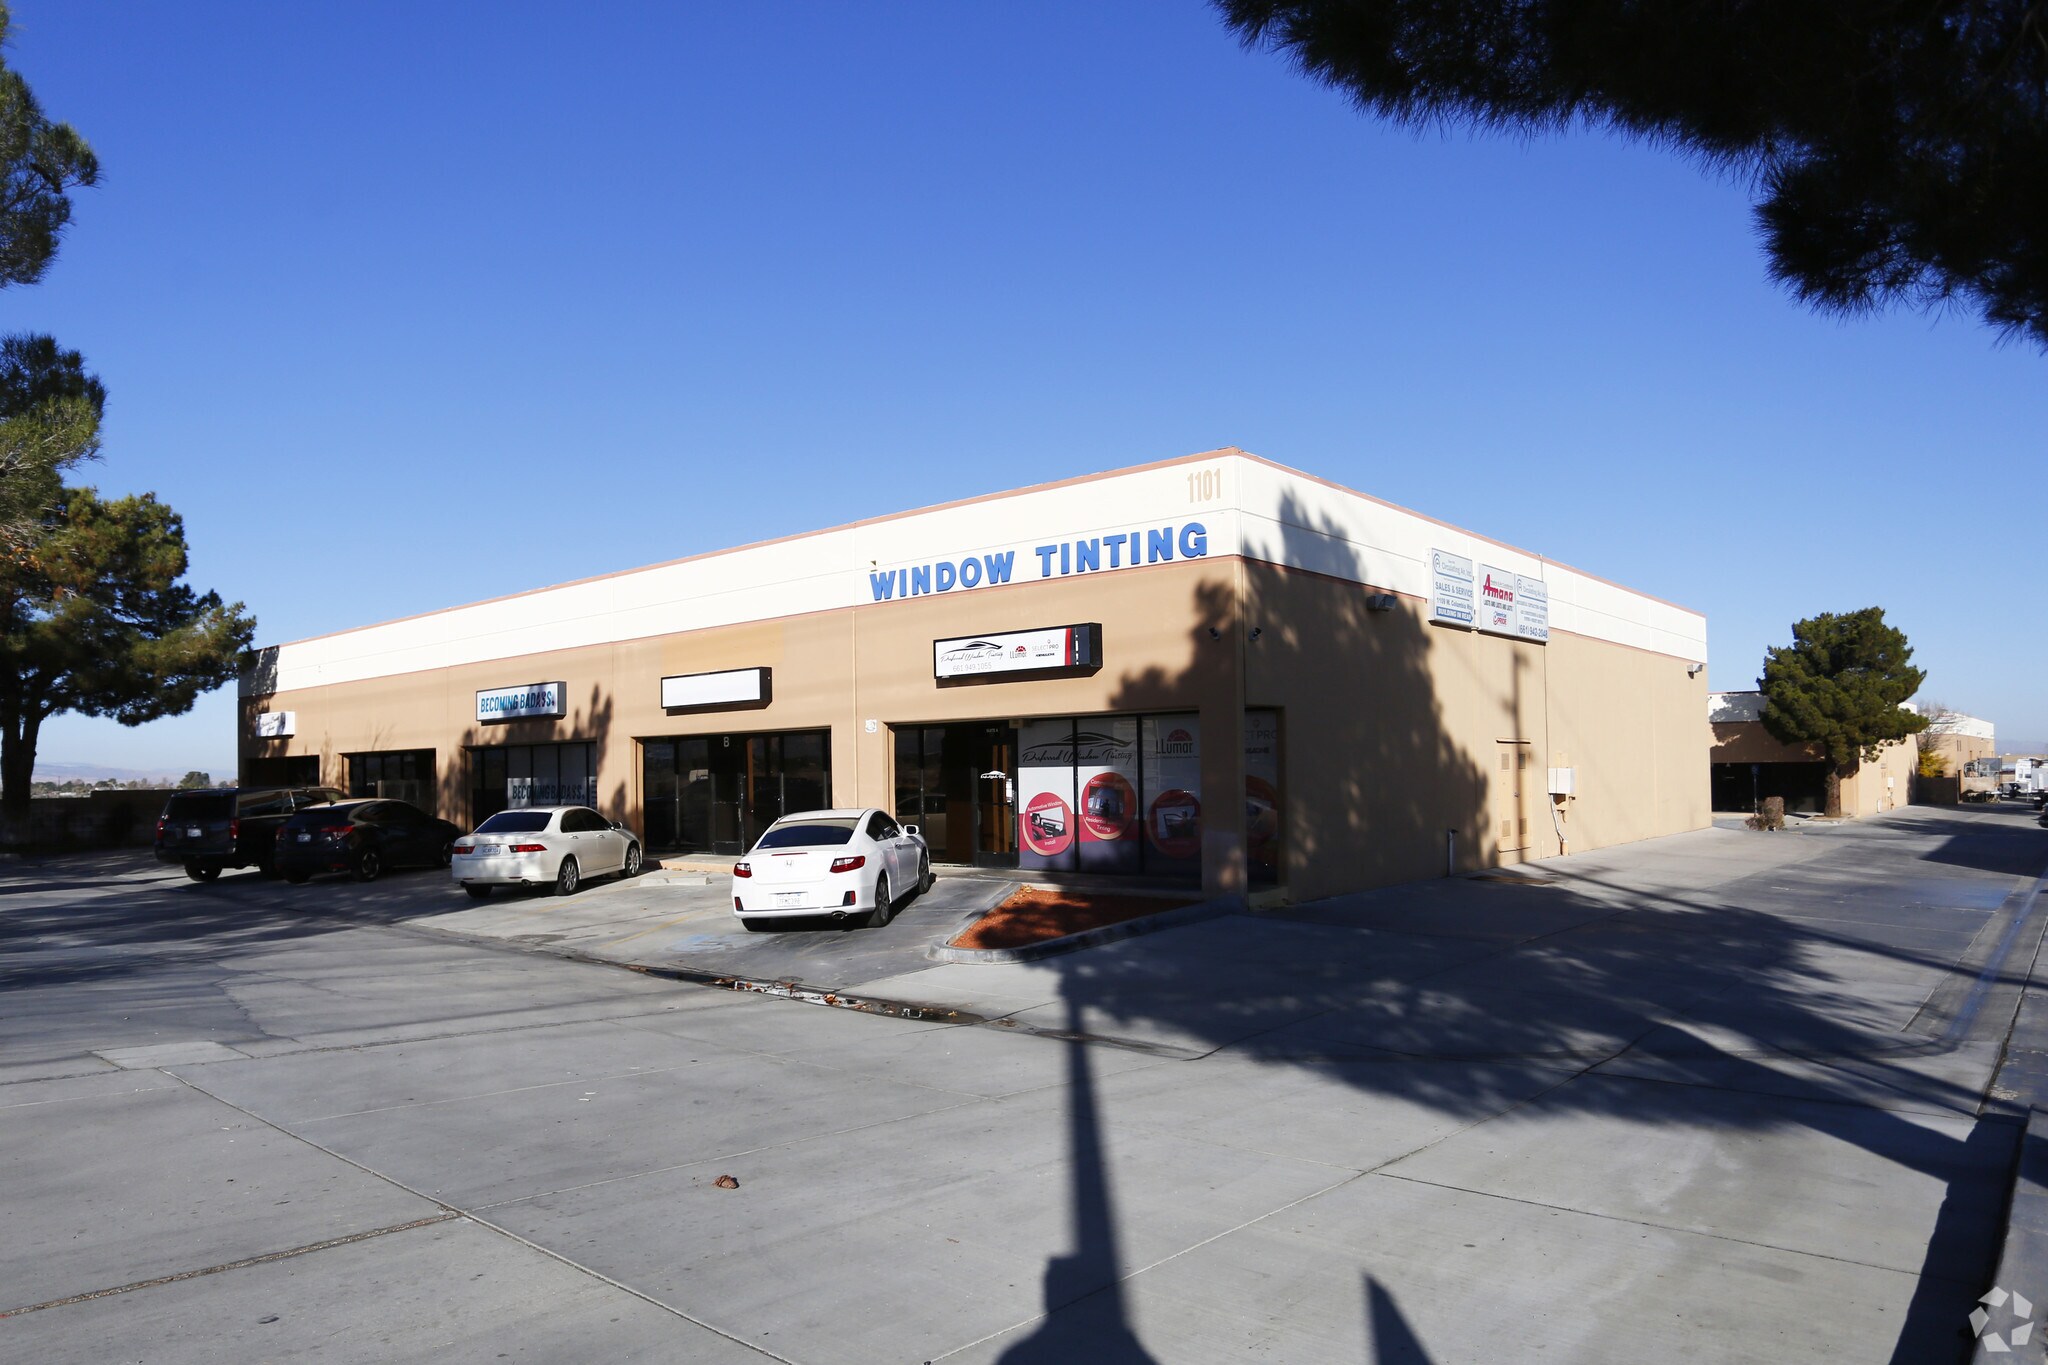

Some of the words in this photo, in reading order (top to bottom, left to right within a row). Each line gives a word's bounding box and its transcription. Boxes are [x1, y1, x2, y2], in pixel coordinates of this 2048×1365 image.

[1187, 468, 1221, 503] 1101
[869, 551, 1015, 601] WINDOW
[1035, 522, 1208, 577] TINTING
[1435, 581, 1451, 593] SALES
[1451, 585, 1455, 594] &
[1455, 586, 1473, 598] SERVICE
[1483, 574, 1514, 602] Amana
[481, 694, 519, 713] BECOMING
[1027, 802, 1047, 812] Automotive
